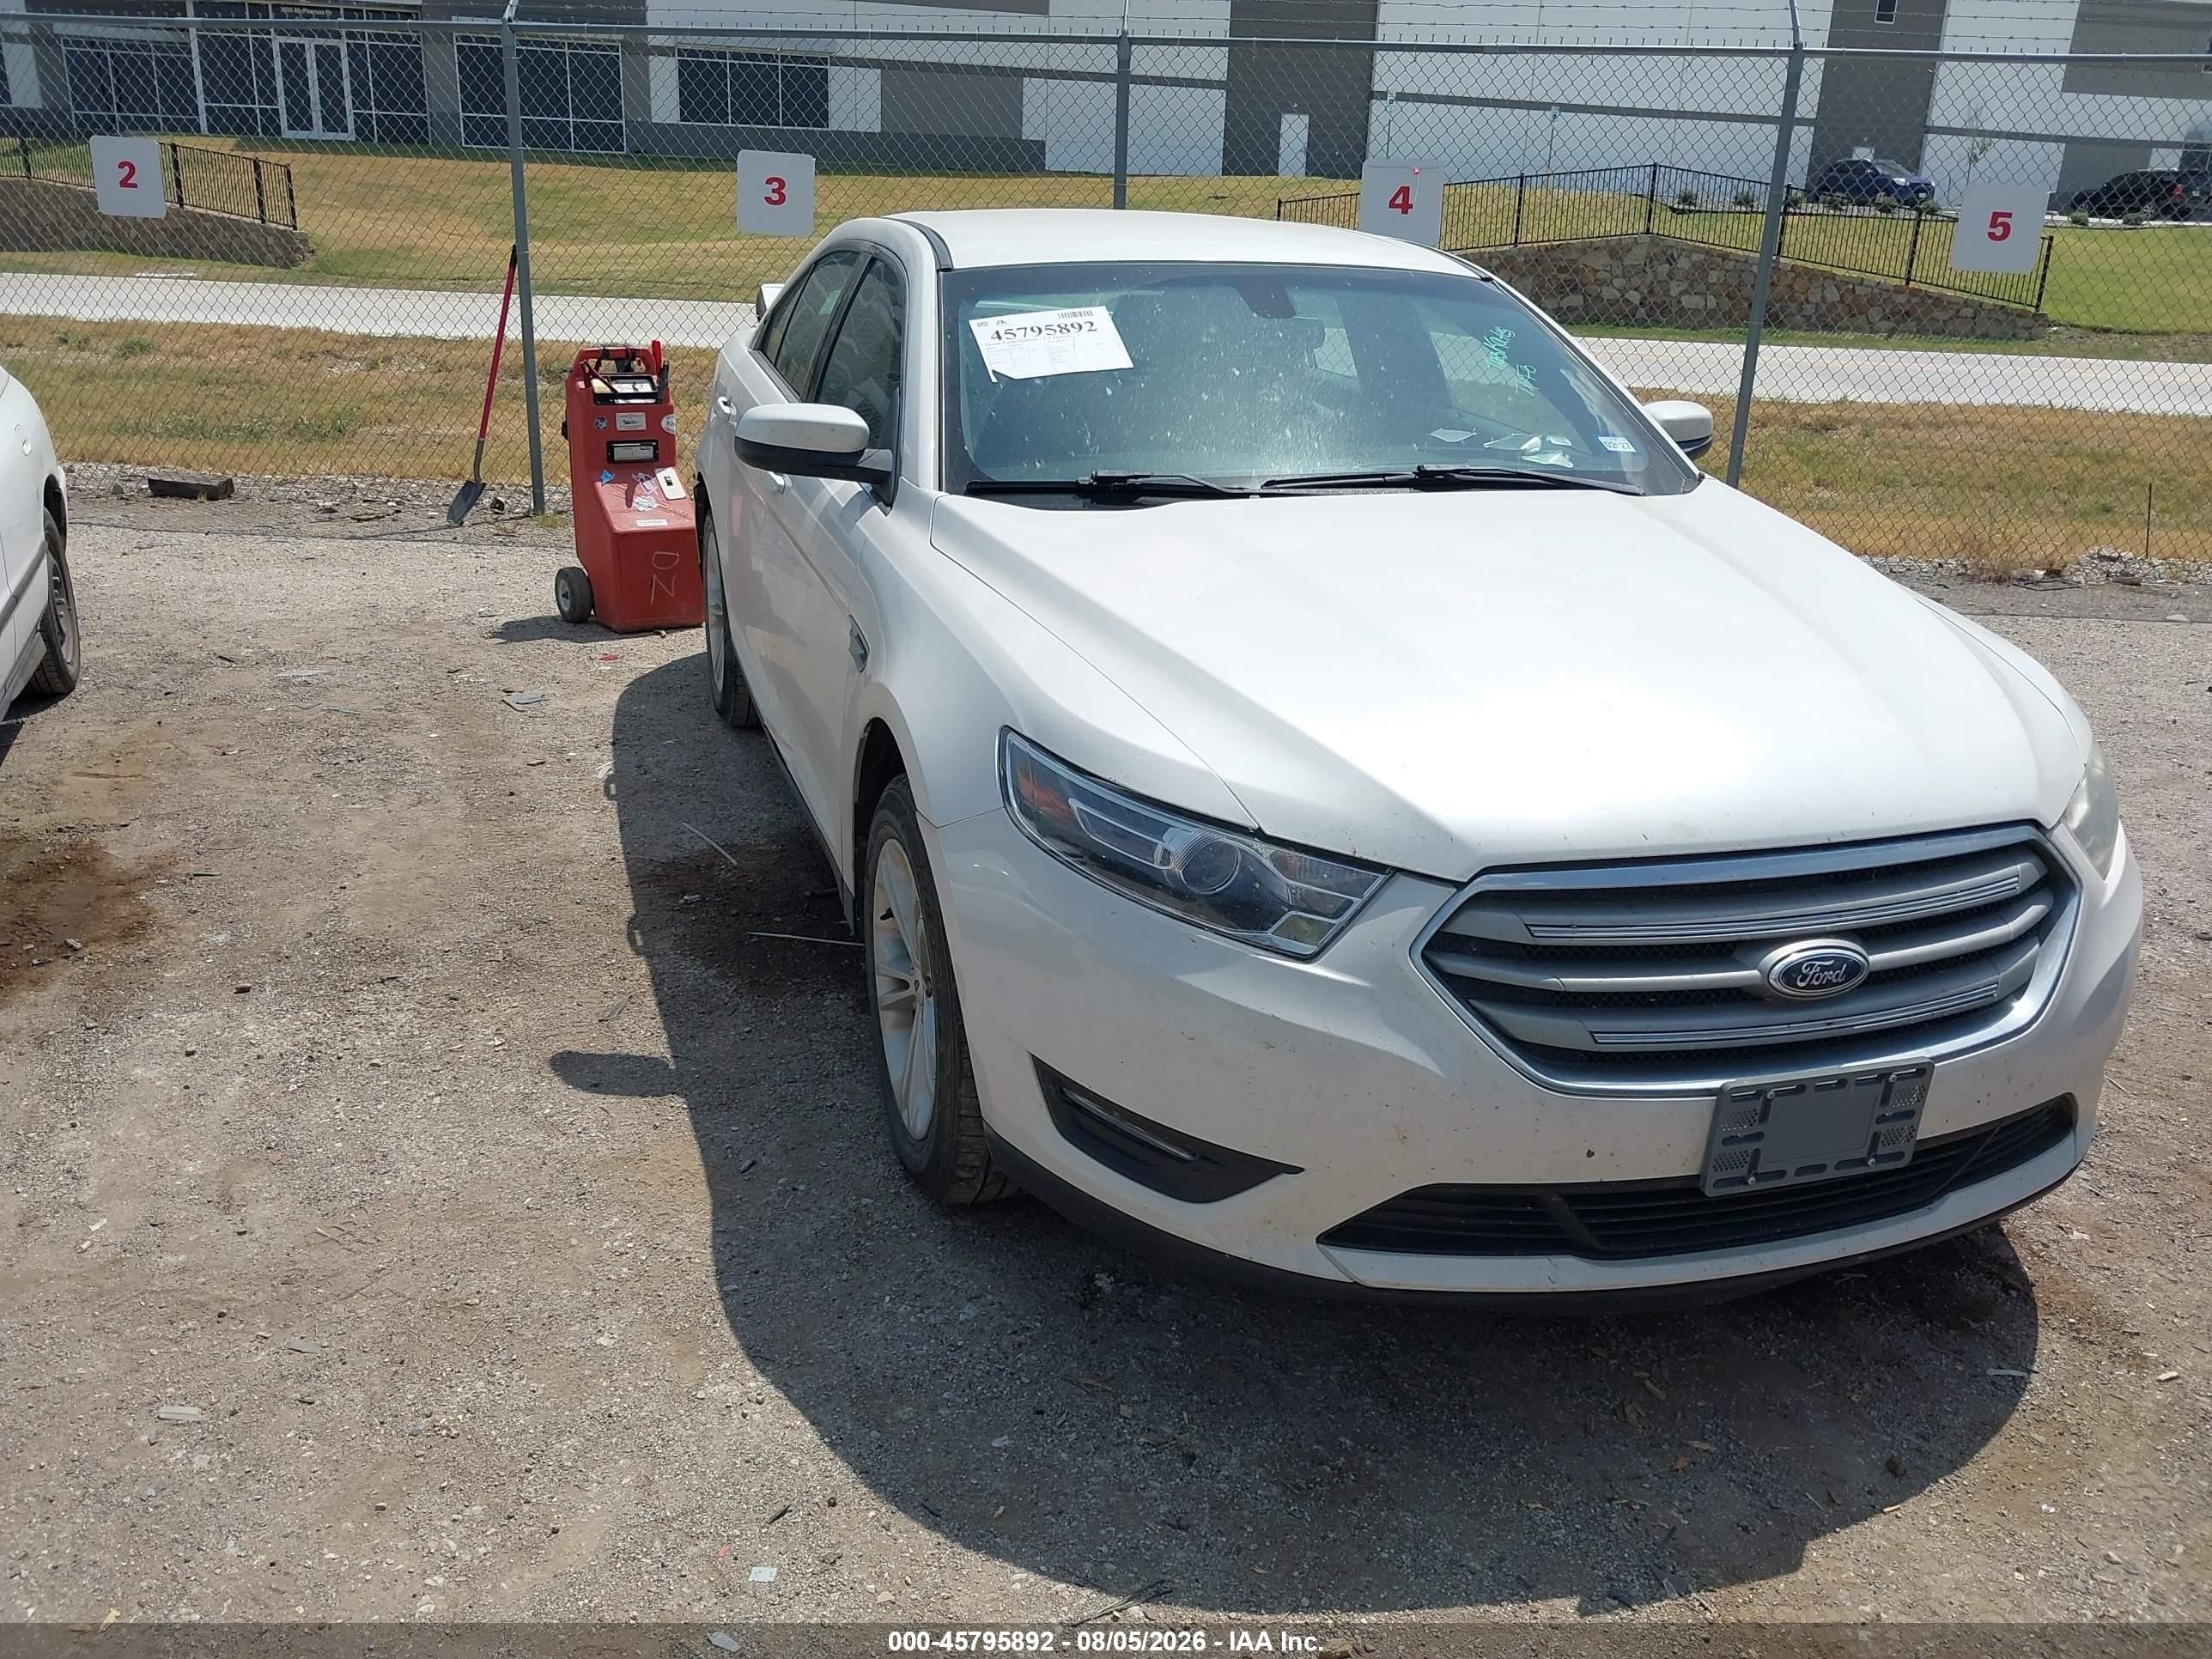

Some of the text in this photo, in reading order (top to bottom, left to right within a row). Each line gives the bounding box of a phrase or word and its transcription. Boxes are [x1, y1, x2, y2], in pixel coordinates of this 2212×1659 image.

[117, 161, 138, 189] 2
[763, 177, 787, 206] 3
[1388, 185, 1413, 214] 4
[1987, 211, 2012, 241] 5
[990, 320, 1098, 341] 45795892
[1796, 959, 1848, 988] Ford
